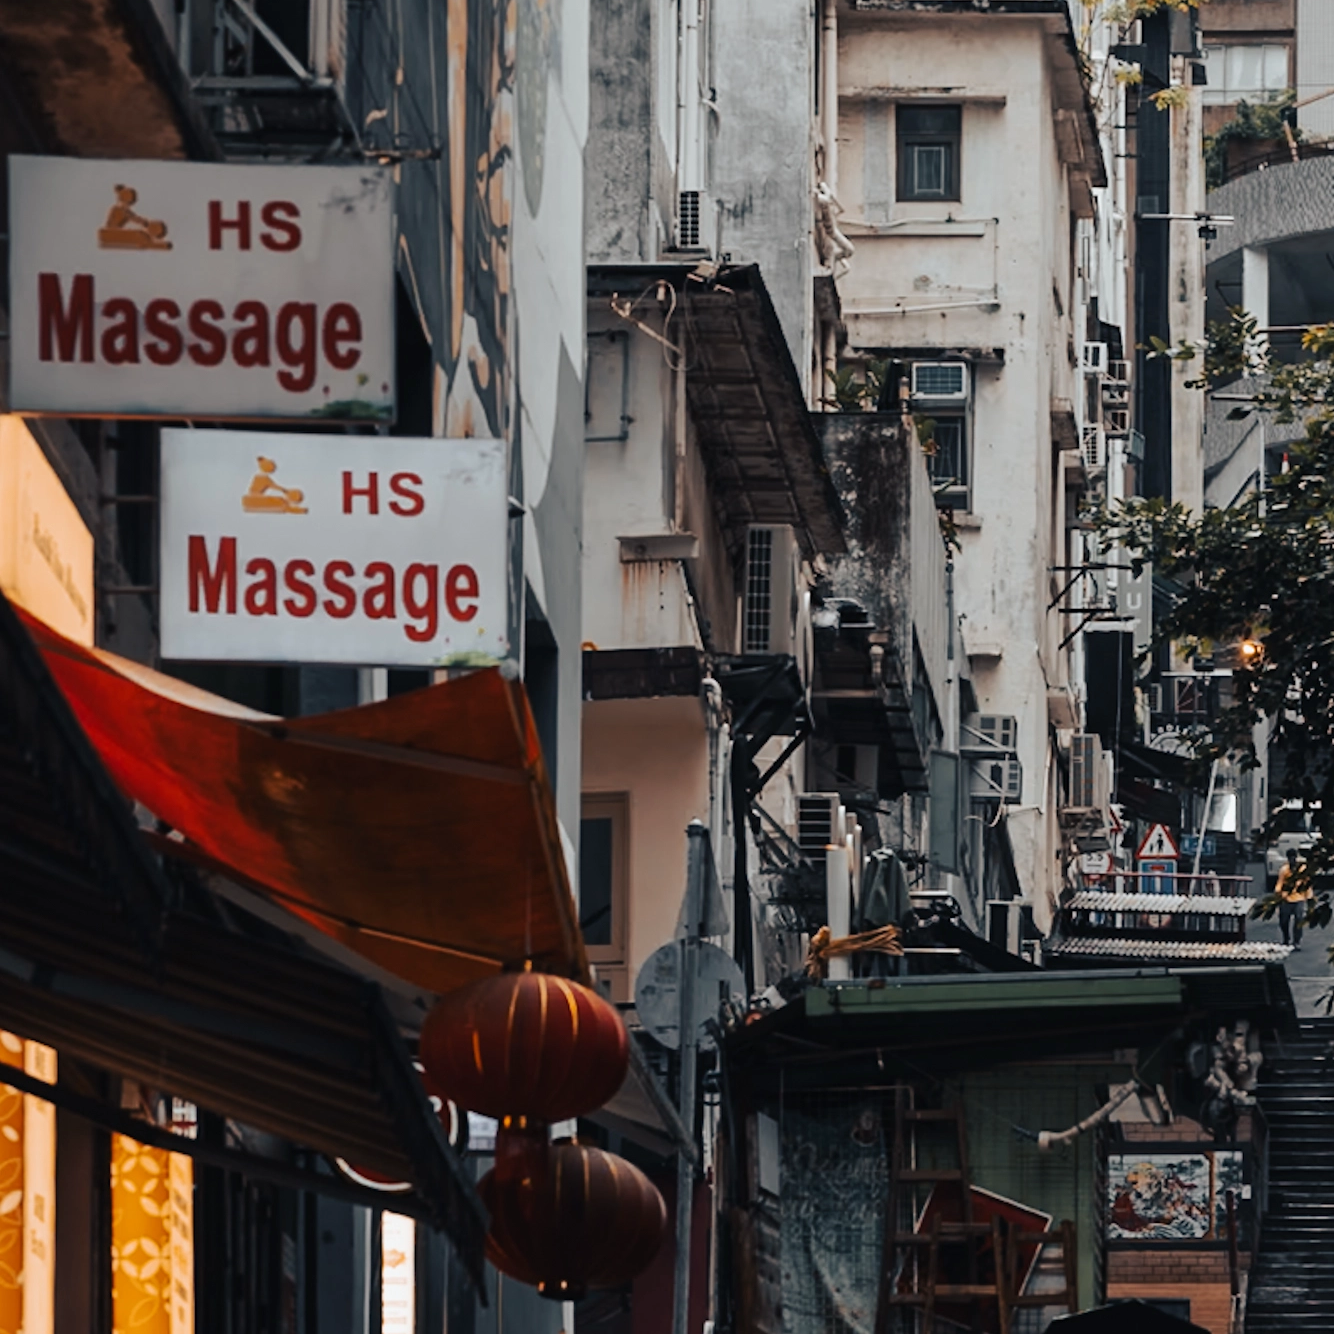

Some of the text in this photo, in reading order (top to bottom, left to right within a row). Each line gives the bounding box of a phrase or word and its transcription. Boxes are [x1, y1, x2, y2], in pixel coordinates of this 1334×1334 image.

[208, 199, 303, 252] HS
[38, 271, 364, 394] Massage
[340, 470, 426, 518] HS
[187, 534, 481, 643] Massage
